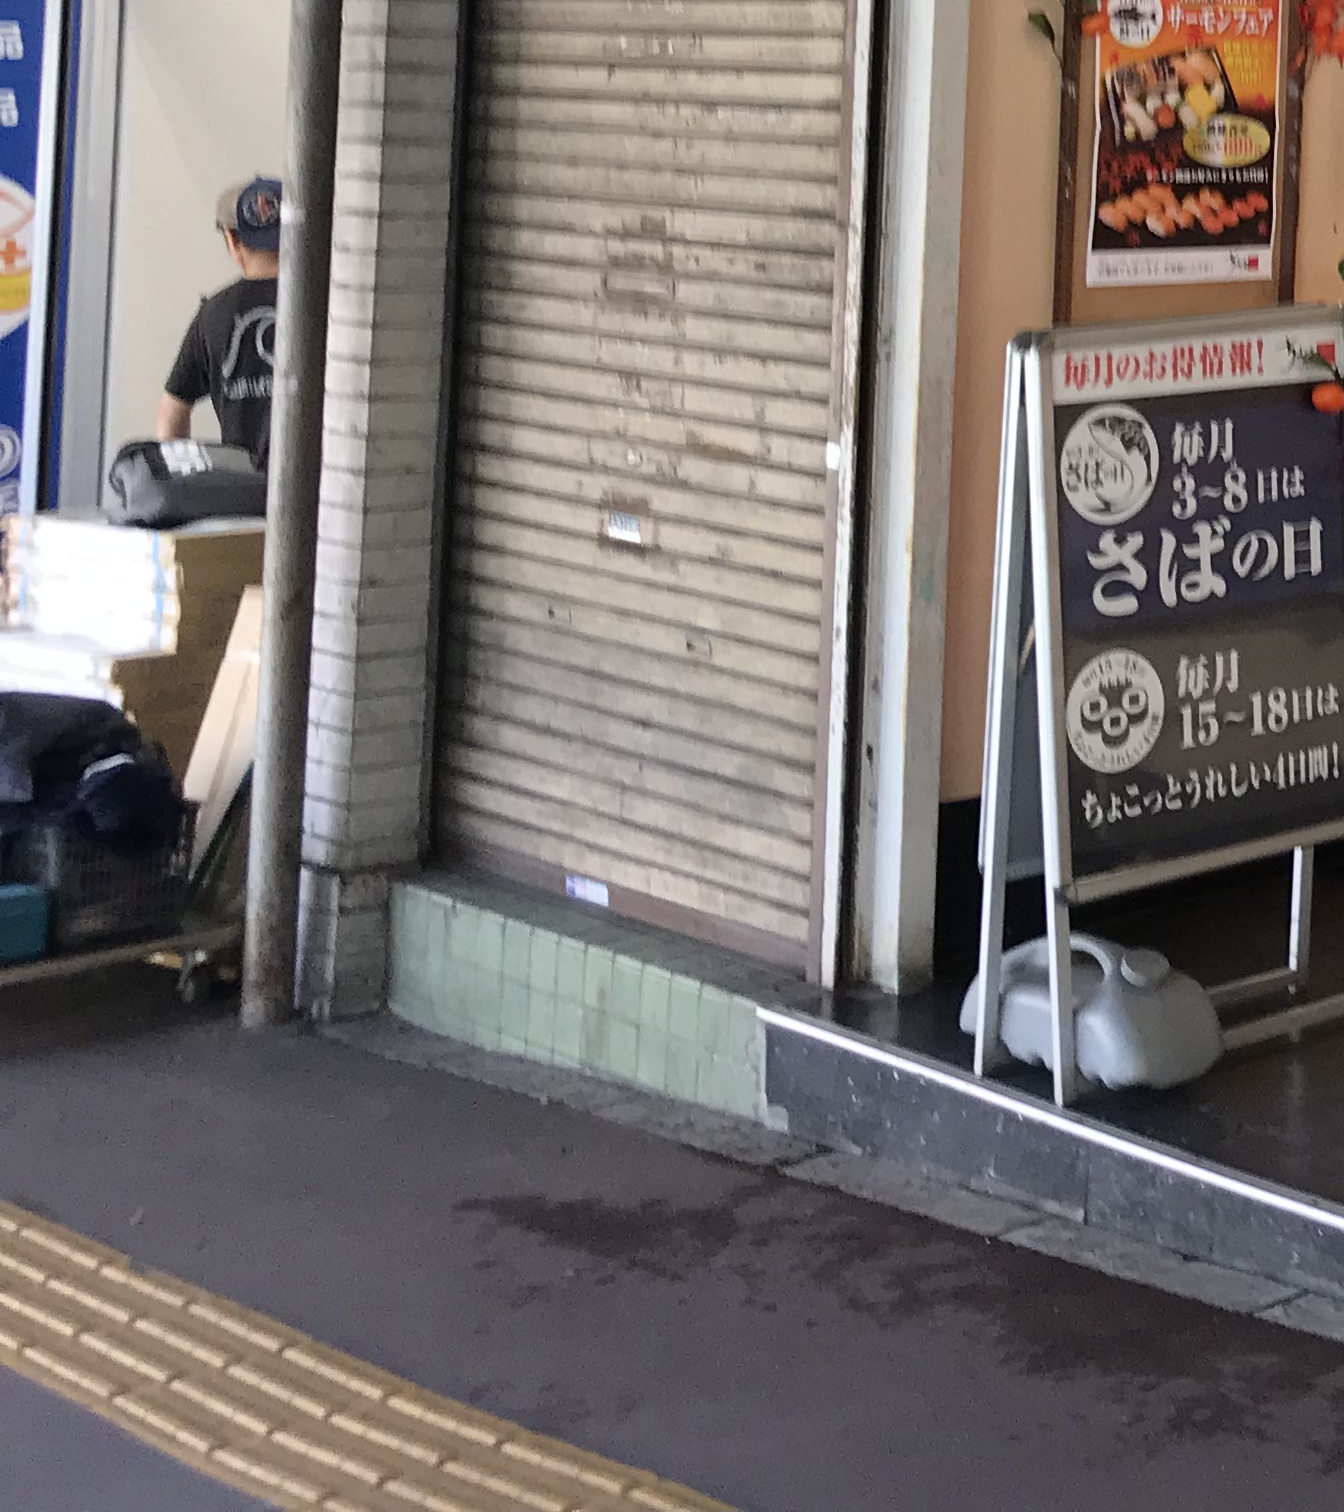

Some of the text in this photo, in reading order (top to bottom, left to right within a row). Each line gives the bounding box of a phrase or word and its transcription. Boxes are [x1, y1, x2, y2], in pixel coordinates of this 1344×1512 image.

[1172, 417, 1236, 466] 毎月
[1086, 515, 1323, 617] さばの日
[1175, 647, 1241, 700] 毎月
